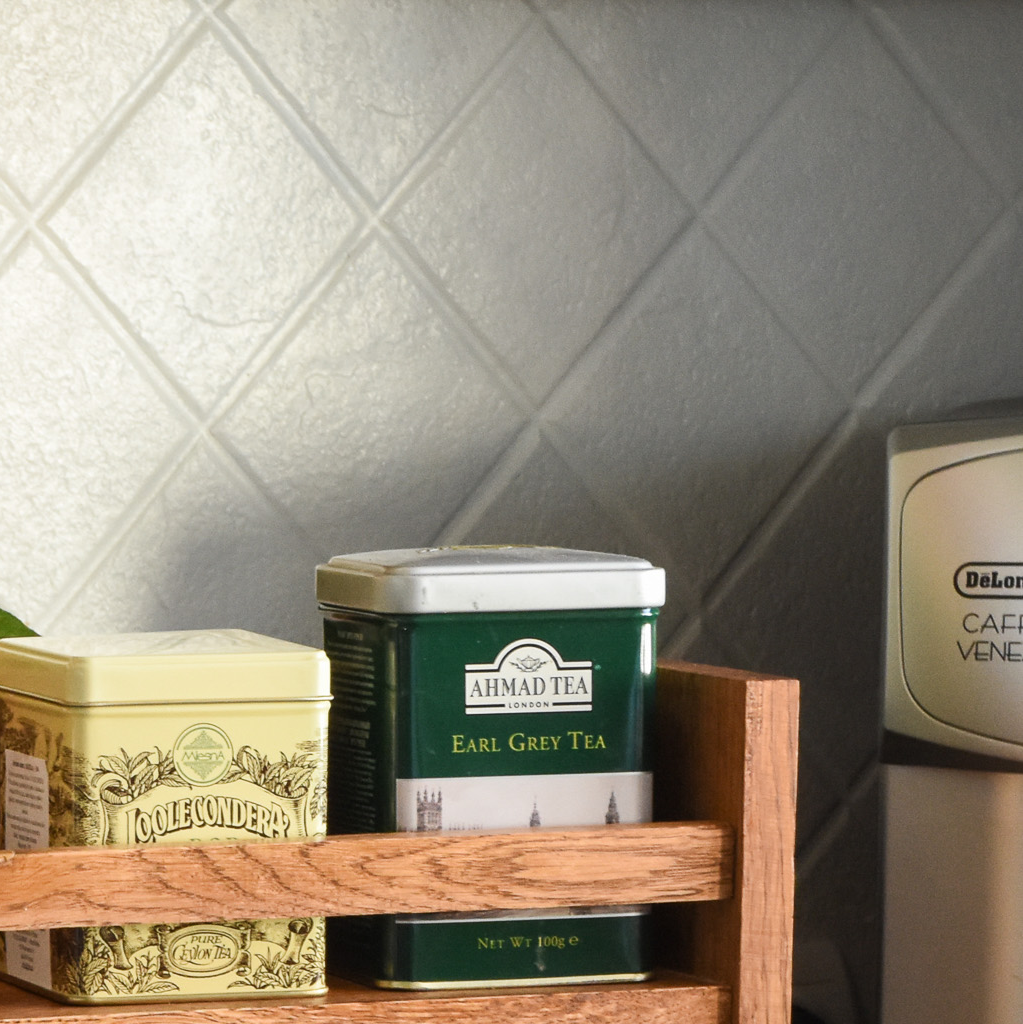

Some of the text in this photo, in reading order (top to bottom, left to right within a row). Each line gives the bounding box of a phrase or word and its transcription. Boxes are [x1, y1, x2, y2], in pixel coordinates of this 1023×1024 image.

[957, 641, 1023, 662] VENE
[470, 676, 588, 698] AHMAD TEA
[508, 701, 550, 709] LONDON
[191, 935, 223, 945] PURE
[538, 935, 566, 949] 100g
